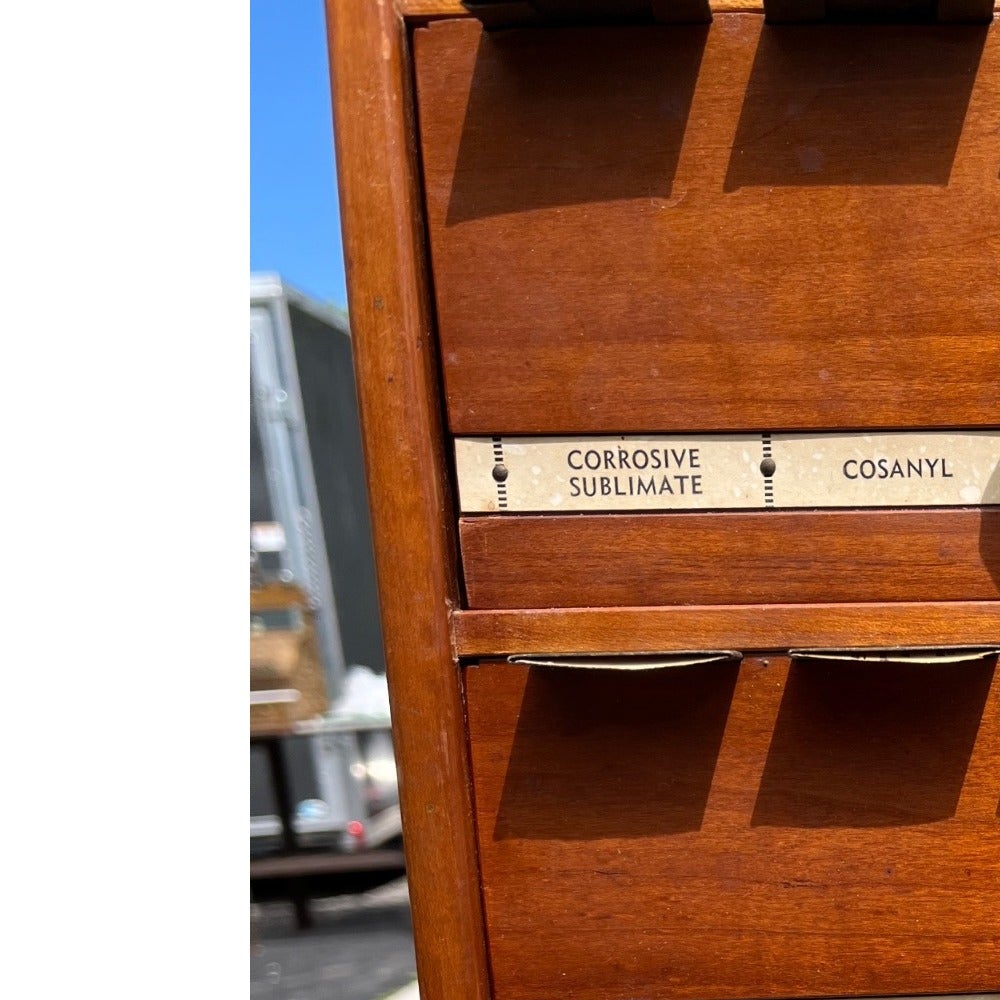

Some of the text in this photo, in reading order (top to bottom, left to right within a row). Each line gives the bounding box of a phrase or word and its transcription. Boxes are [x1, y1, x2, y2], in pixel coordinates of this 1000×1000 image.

[567, 449, 701, 471] CORROSIVE
[842, 458, 953, 480] COSANYL
[569, 475, 703, 498] SUBLIMATE
